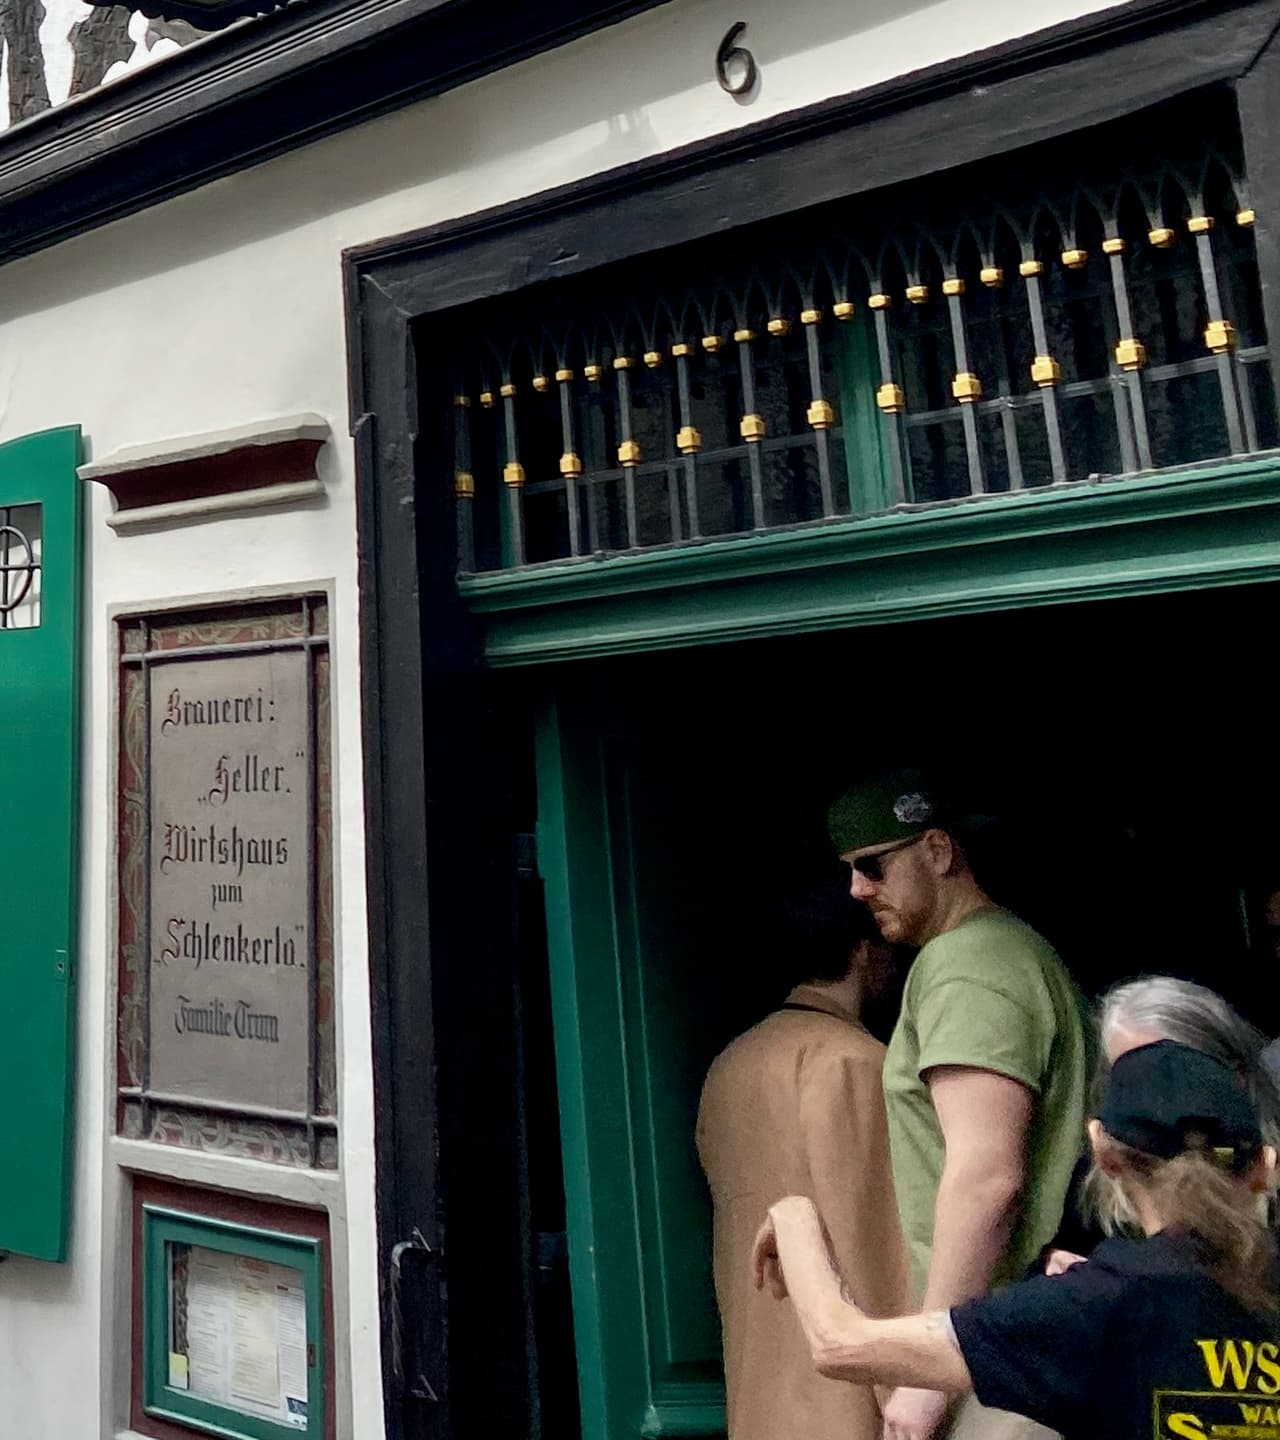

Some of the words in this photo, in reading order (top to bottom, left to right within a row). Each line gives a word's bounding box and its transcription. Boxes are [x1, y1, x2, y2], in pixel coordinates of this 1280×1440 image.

[716, 21, 757, 95] 6
[160, 823, 288, 877] Wirtshaus
[211, 884, 243, 911] zum
[174, 994, 232, 1037] Familie
